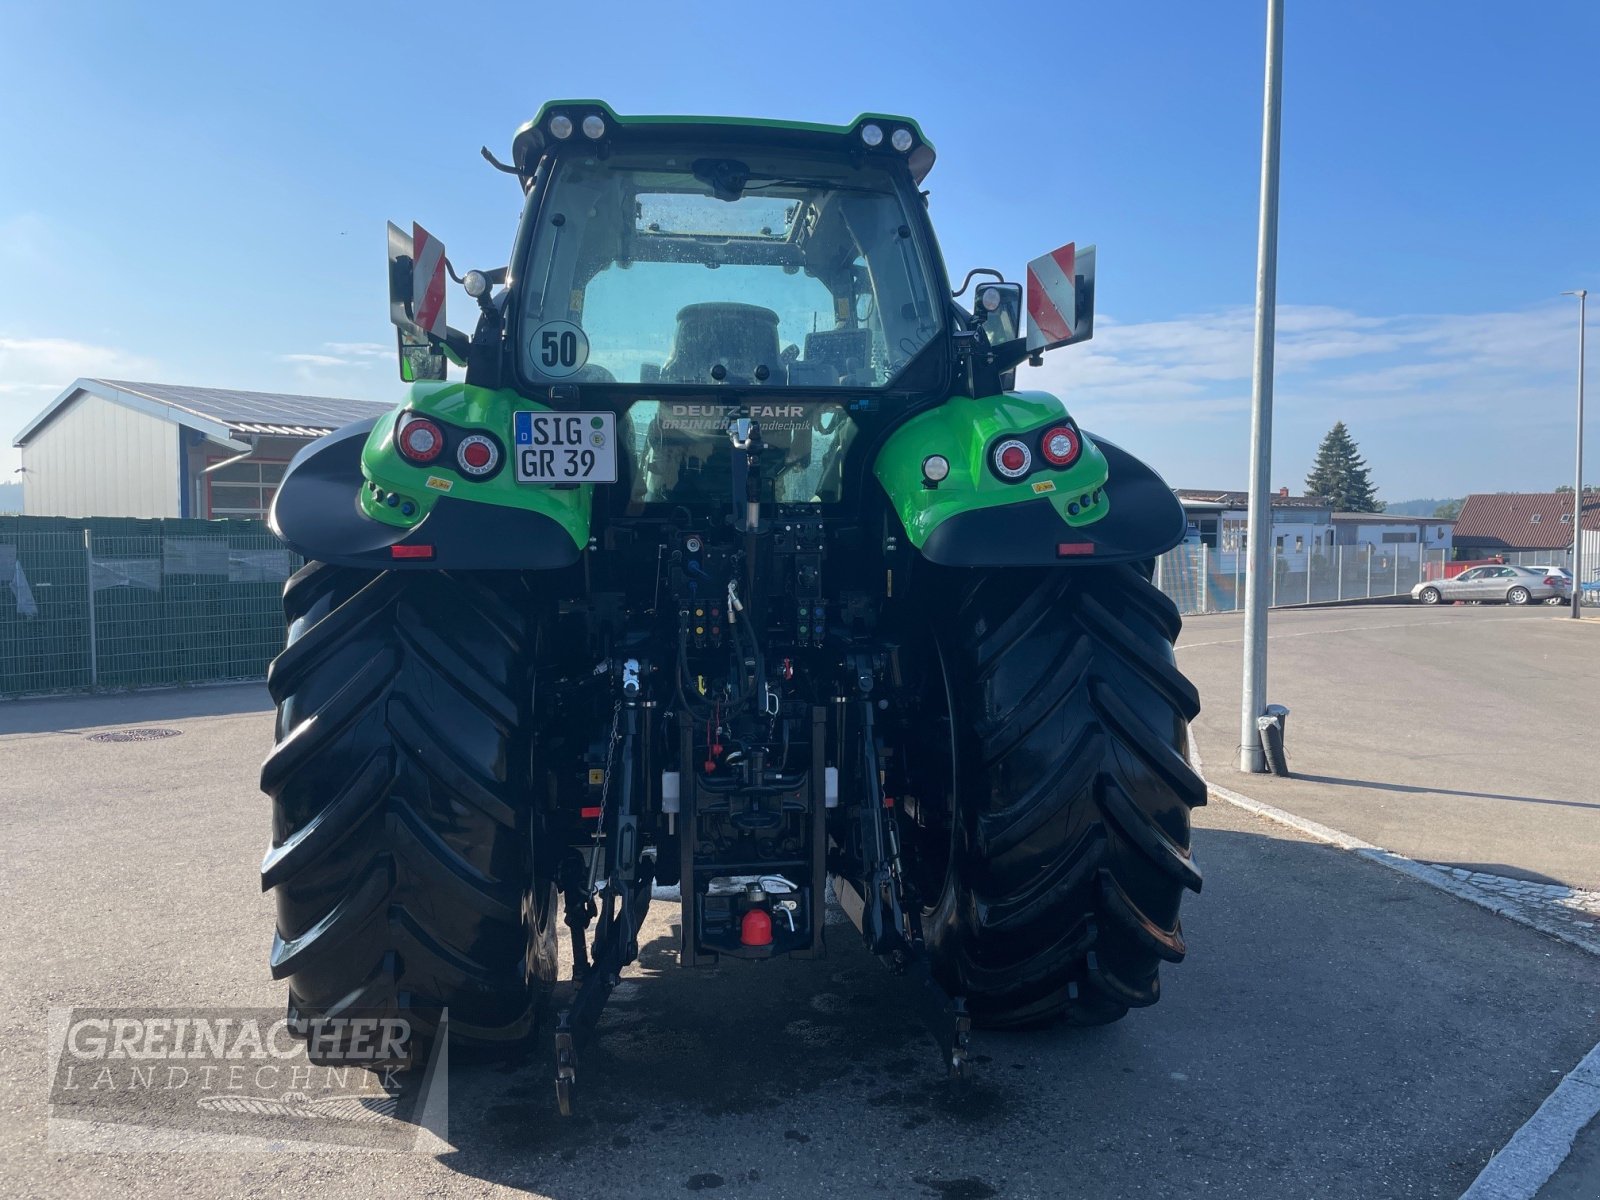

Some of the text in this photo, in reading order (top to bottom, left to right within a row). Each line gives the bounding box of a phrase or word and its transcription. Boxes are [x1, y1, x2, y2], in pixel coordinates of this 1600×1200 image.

[541, 331, 577, 367] 50
[673, 405, 804, 418] DEUTZ-FAHR
[534, 417, 582, 446] SIG
[662, 418, 811, 431] GREINACH ndtechnik
[521, 432, 528, 441] D
[522, 449, 596, 478] GR 39
